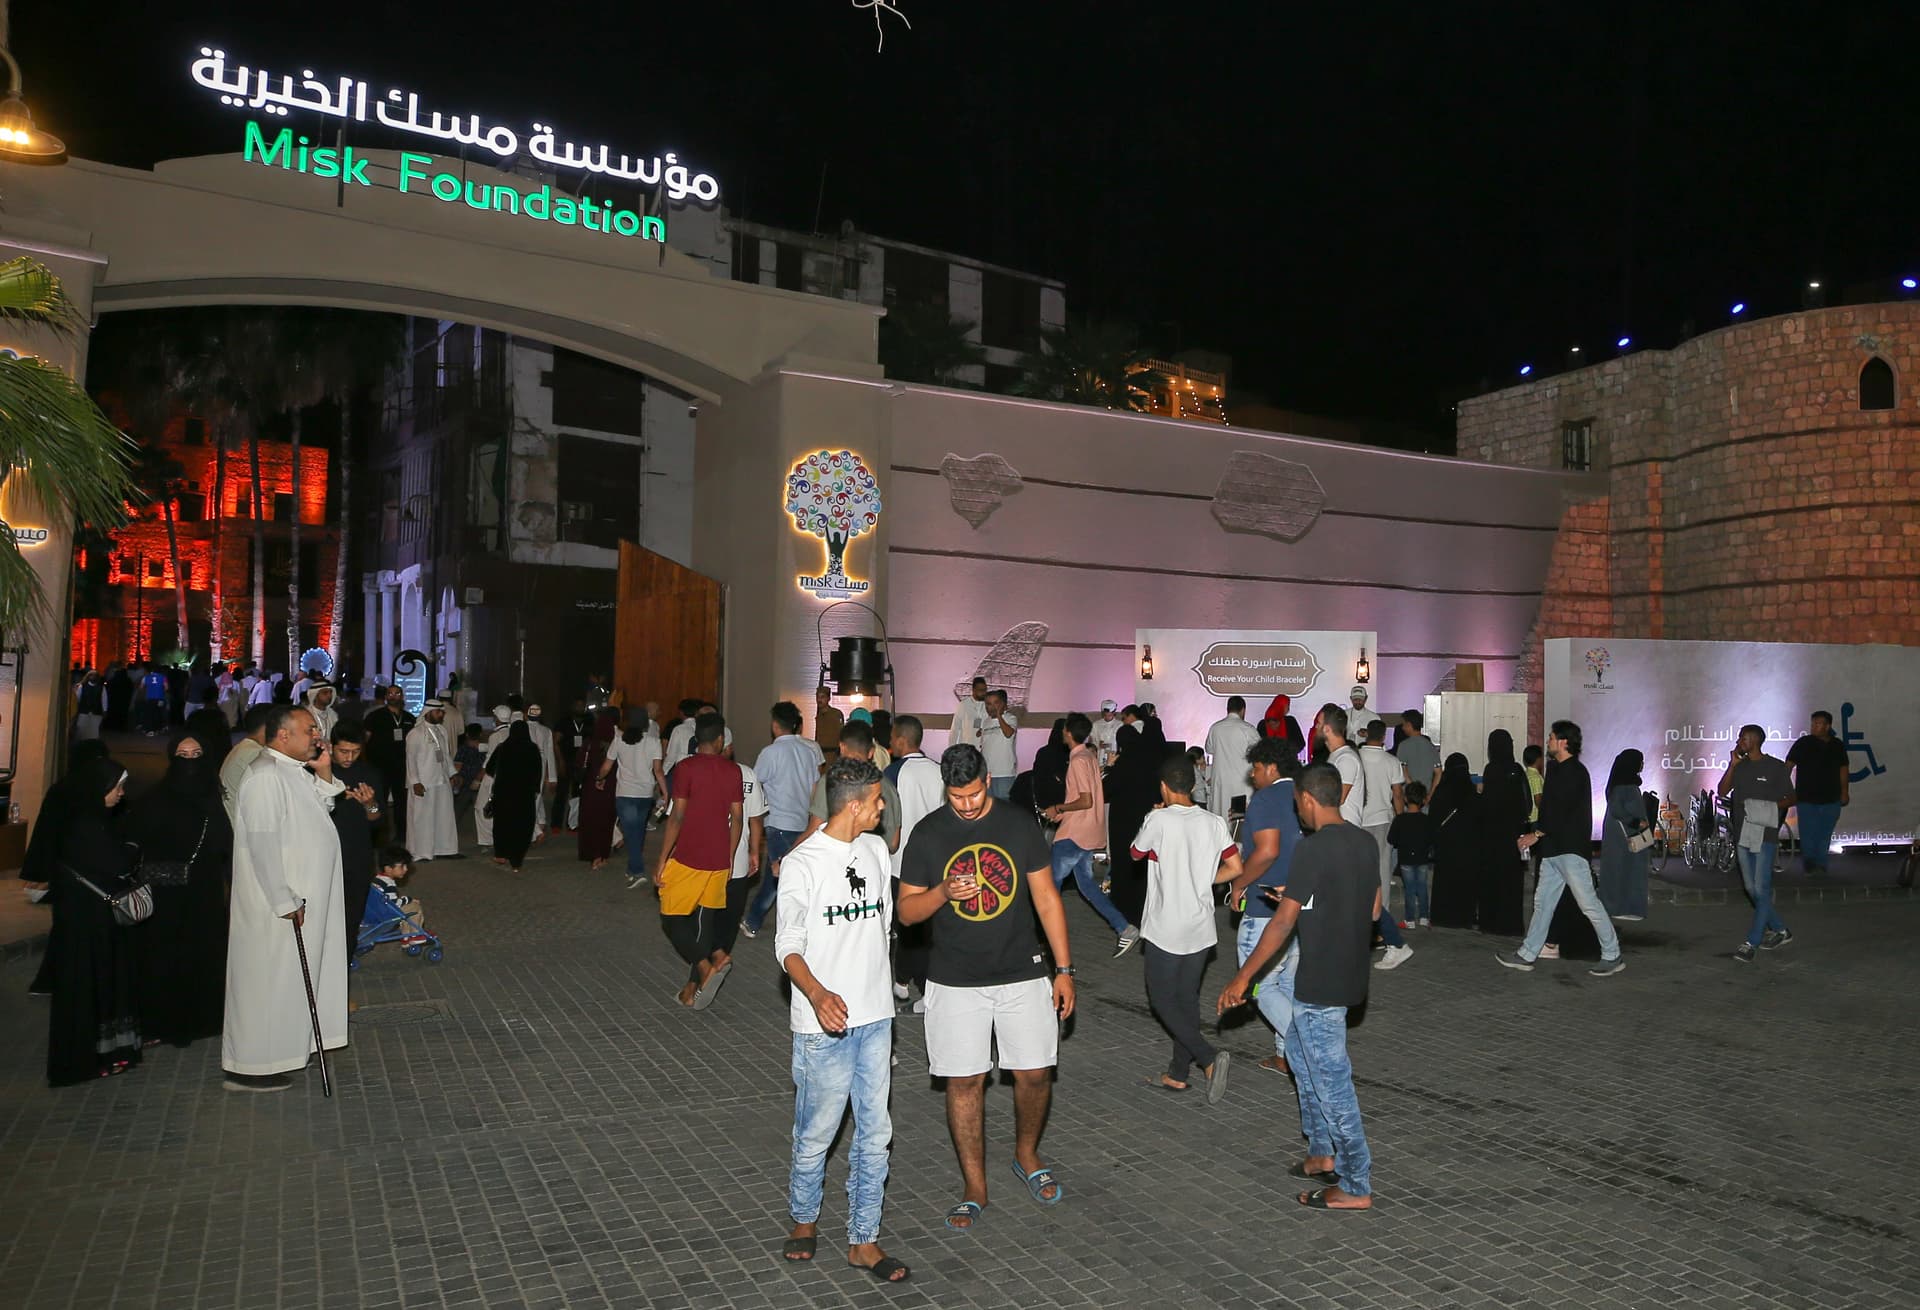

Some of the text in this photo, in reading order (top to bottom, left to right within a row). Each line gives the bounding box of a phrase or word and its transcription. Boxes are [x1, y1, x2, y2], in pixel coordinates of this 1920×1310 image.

[191, 46, 720, 202] مؤسسة مسك الخيرية
[243, 120, 667, 243] Misk Foundation
[1208, 656, 1241, 667] طفلك
[1207, 674, 1306, 684] Receive Your Child Bracelet
[1664, 724, 1733, 745] استلام
[823, 896, 884, 925] POLO
